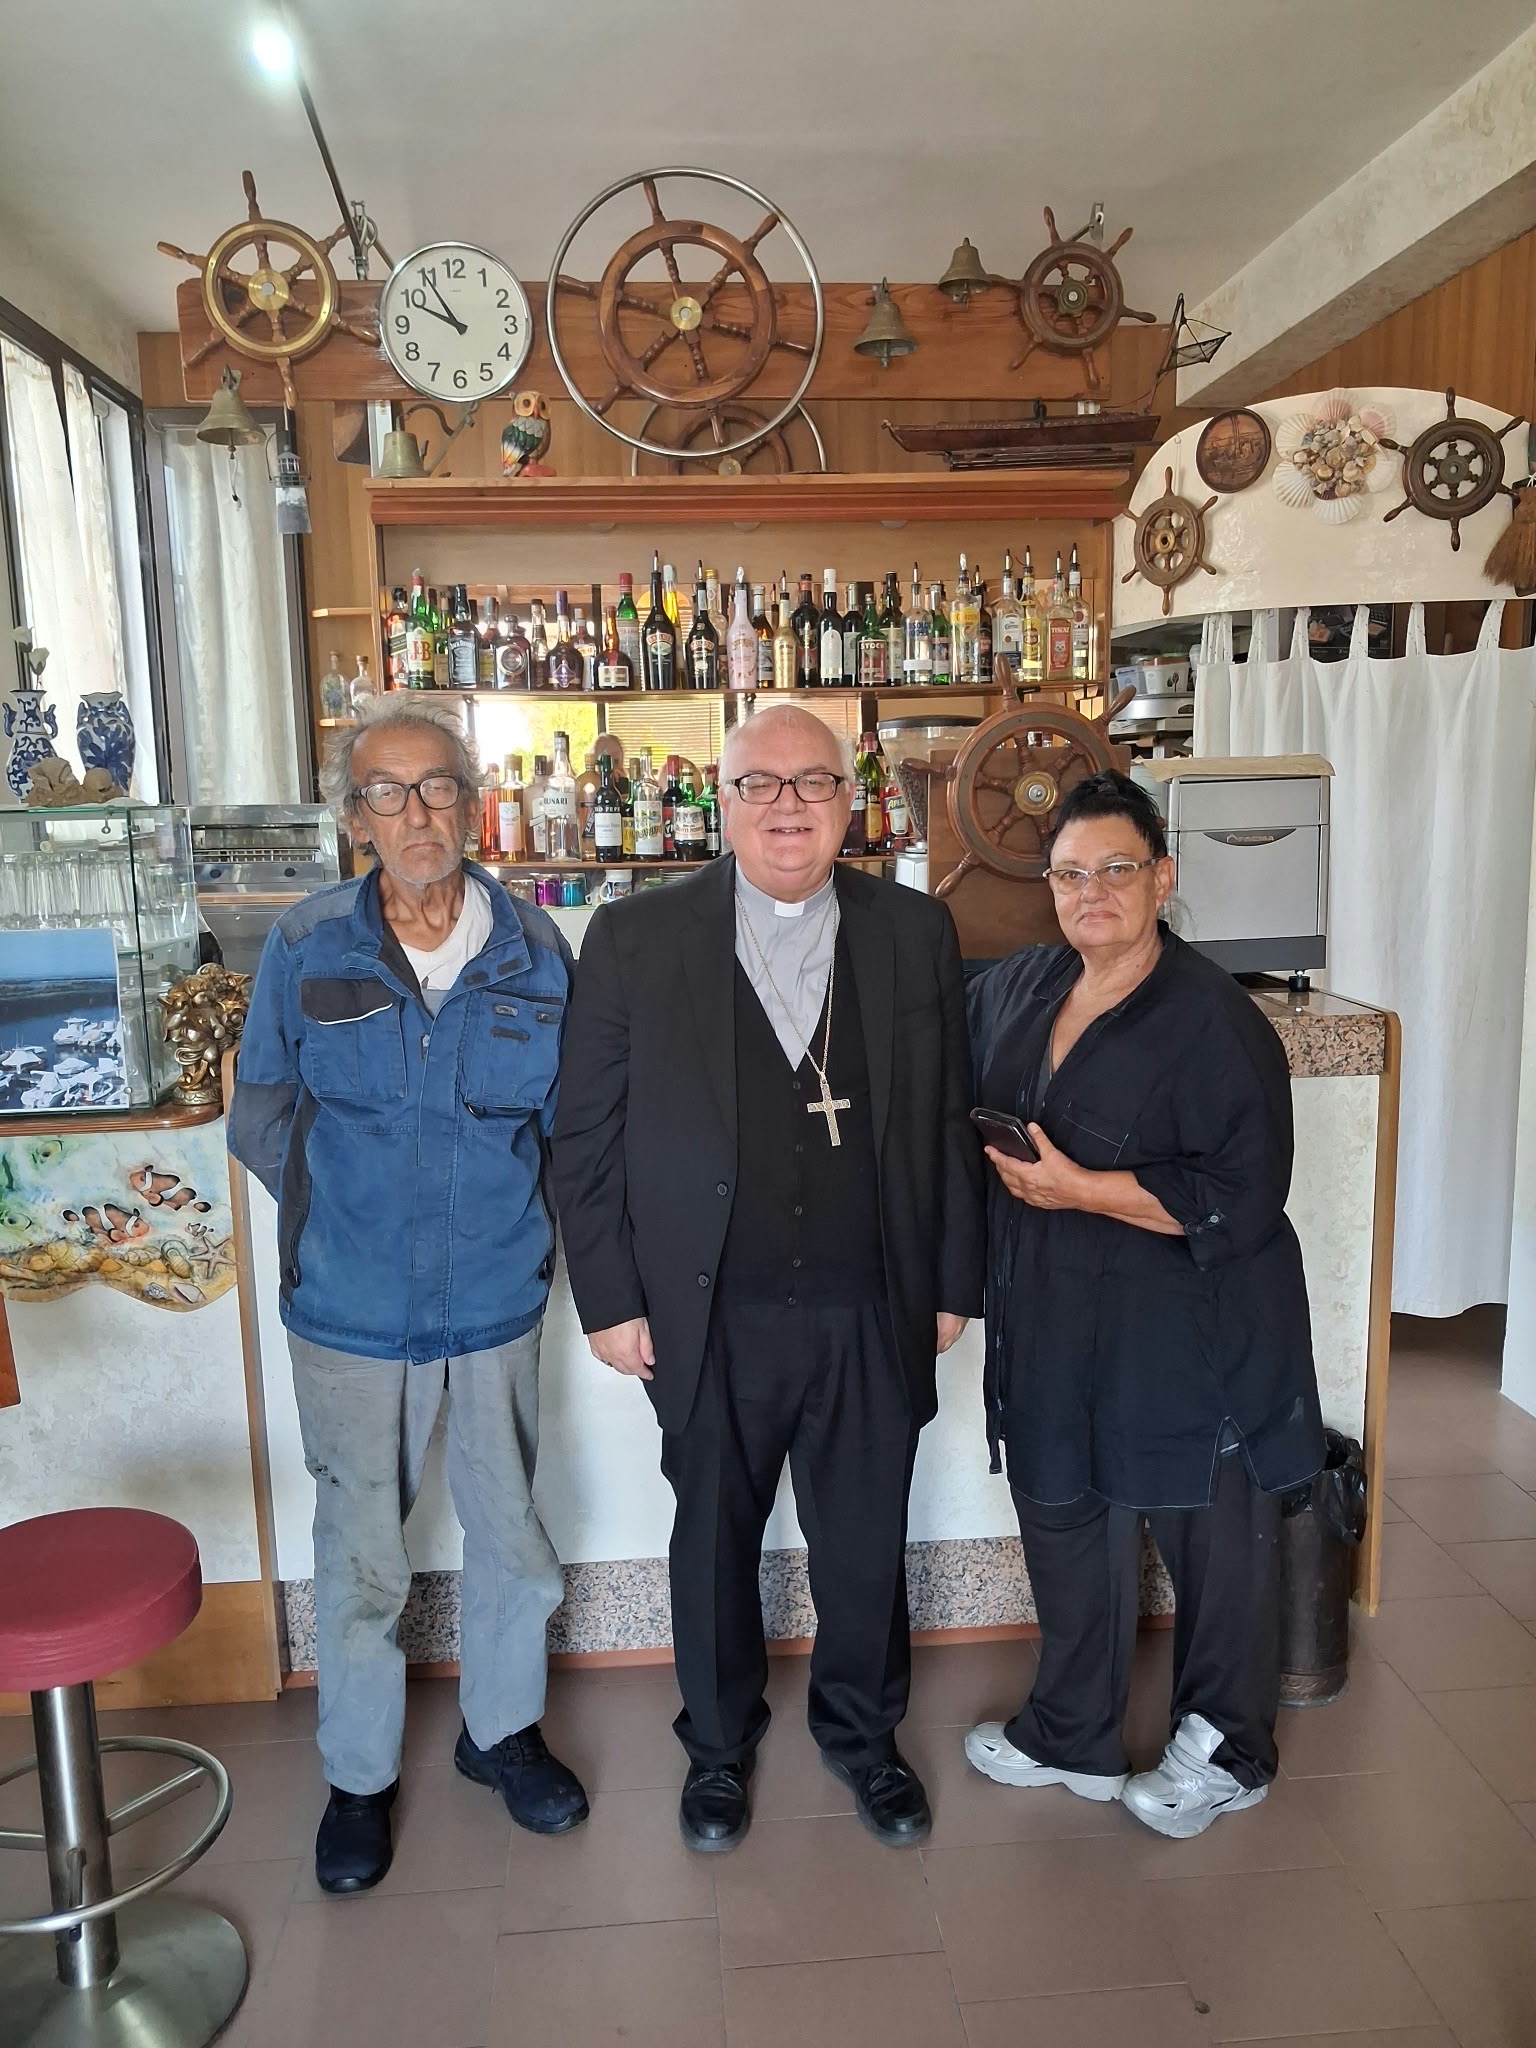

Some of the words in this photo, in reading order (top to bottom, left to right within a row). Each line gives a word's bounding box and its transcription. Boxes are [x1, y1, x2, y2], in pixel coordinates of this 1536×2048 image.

[417, 267, 437, 287] 11
[442, 258, 466, 279] 12
[477, 268, 487, 287] 1
[400, 289, 427, 308] 10
[495, 289, 510, 308] 2
[395, 315, 410, 335] 9
[504, 315, 518, 335] 3
[405, 342, 420, 361] 8
[497, 343, 512, 361] 4
[427, 362, 441, 382] 7
[453, 370, 468, 389] 6
[479, 363, 494, 381] 5
